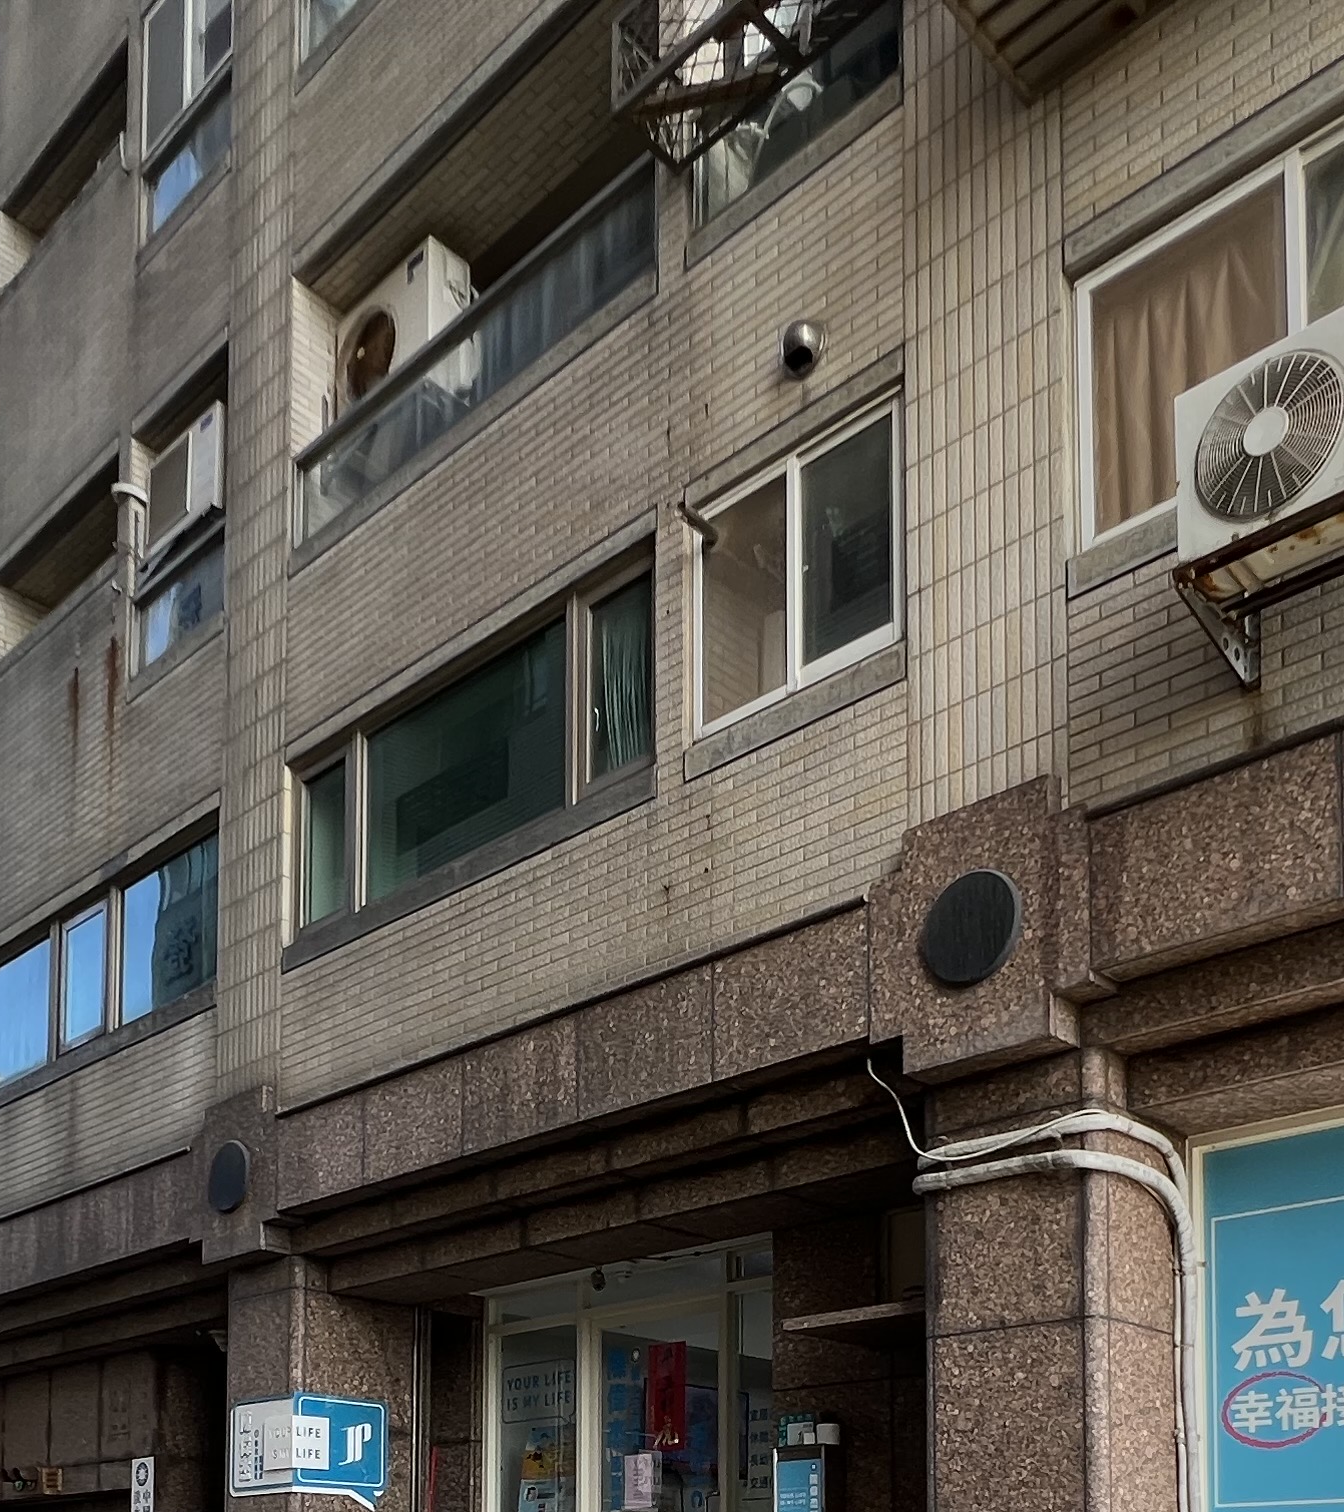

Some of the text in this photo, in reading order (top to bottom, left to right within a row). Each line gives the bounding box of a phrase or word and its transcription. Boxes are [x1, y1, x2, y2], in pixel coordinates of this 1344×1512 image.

[507, 1370, 572, 1392] YOUR LIFE
[507, 1390, 572, 1412] IS MY LIFE
[295, 1425, 322, 1439] LIFE
[295, 1447, 322, 1460] LIFE
